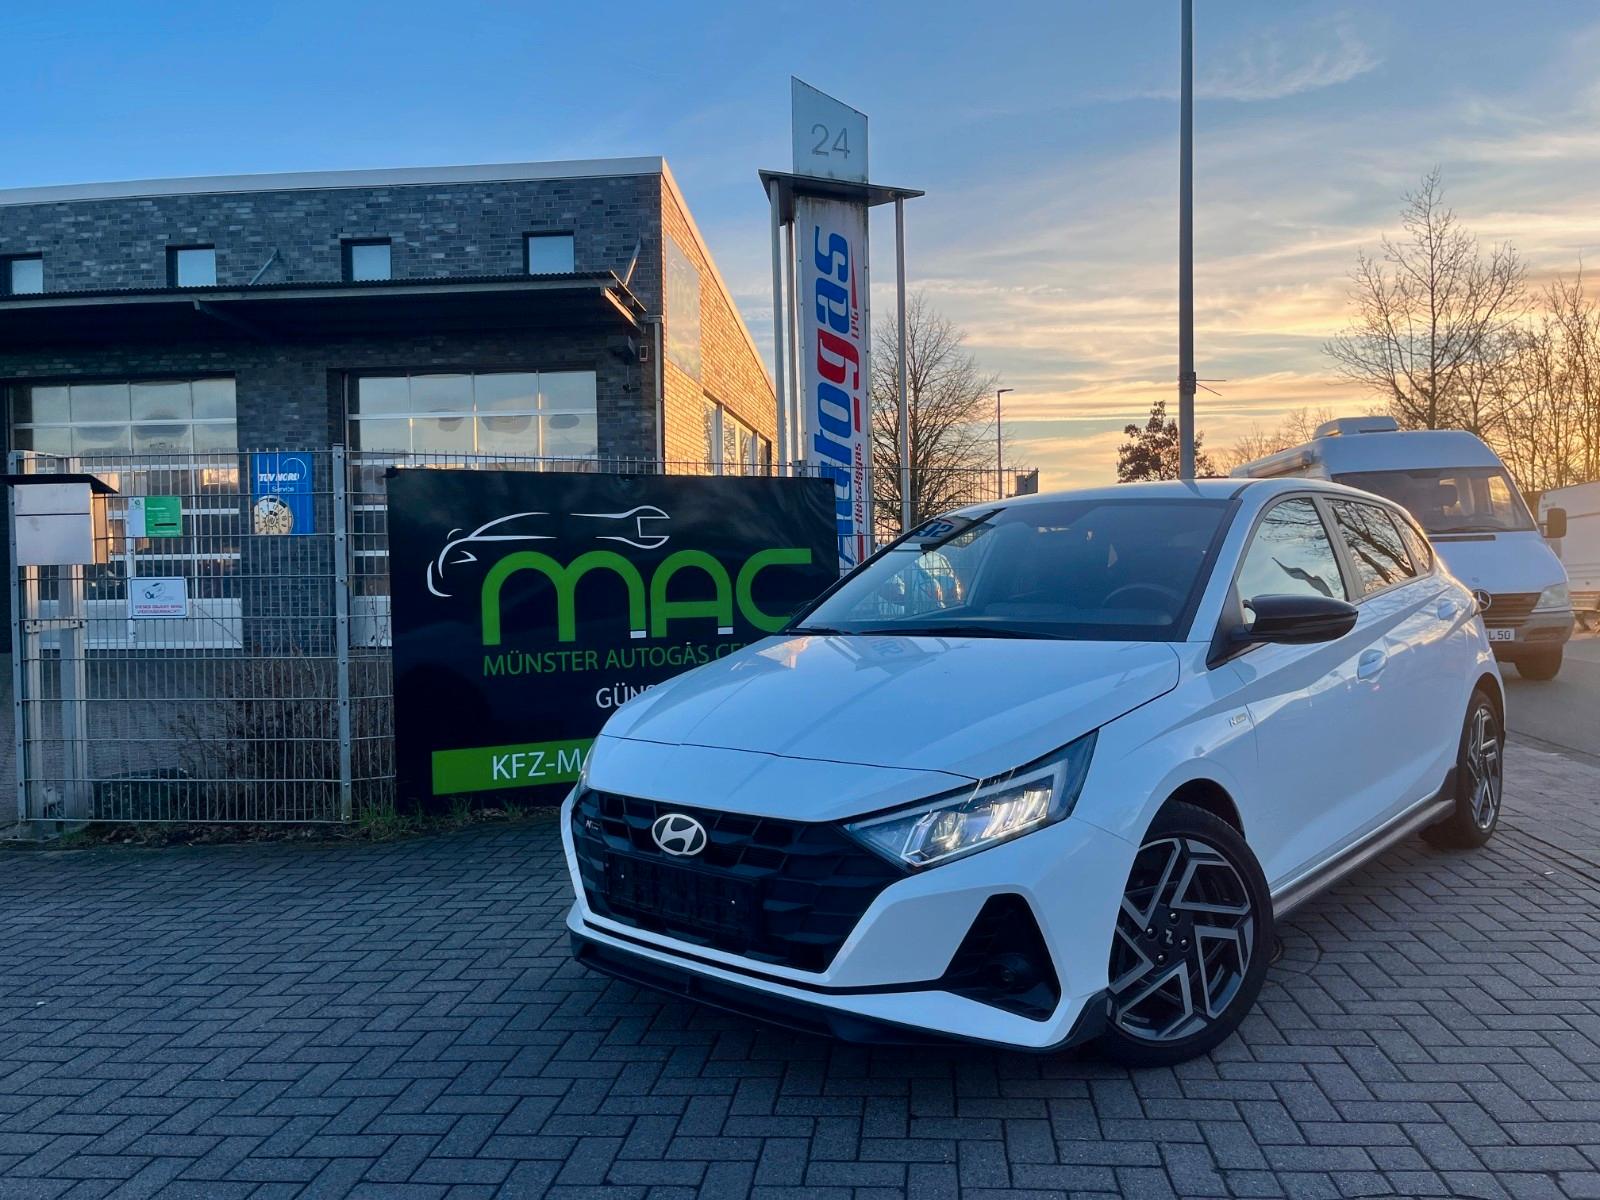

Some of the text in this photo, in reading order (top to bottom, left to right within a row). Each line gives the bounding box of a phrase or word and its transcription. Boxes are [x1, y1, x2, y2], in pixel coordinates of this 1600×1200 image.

[811, 123, 850, 160] 24
[851, 308, 860, 340] LPG
[276, 472, 300, 482] NORD
[481, 548, 812, 646] MAC
[1497, 630, 1511, 640] 50
[483, 642, 749, 676] MÜNSTER AUTOGAS CE
[595, 682, 658, 709] GÜN
